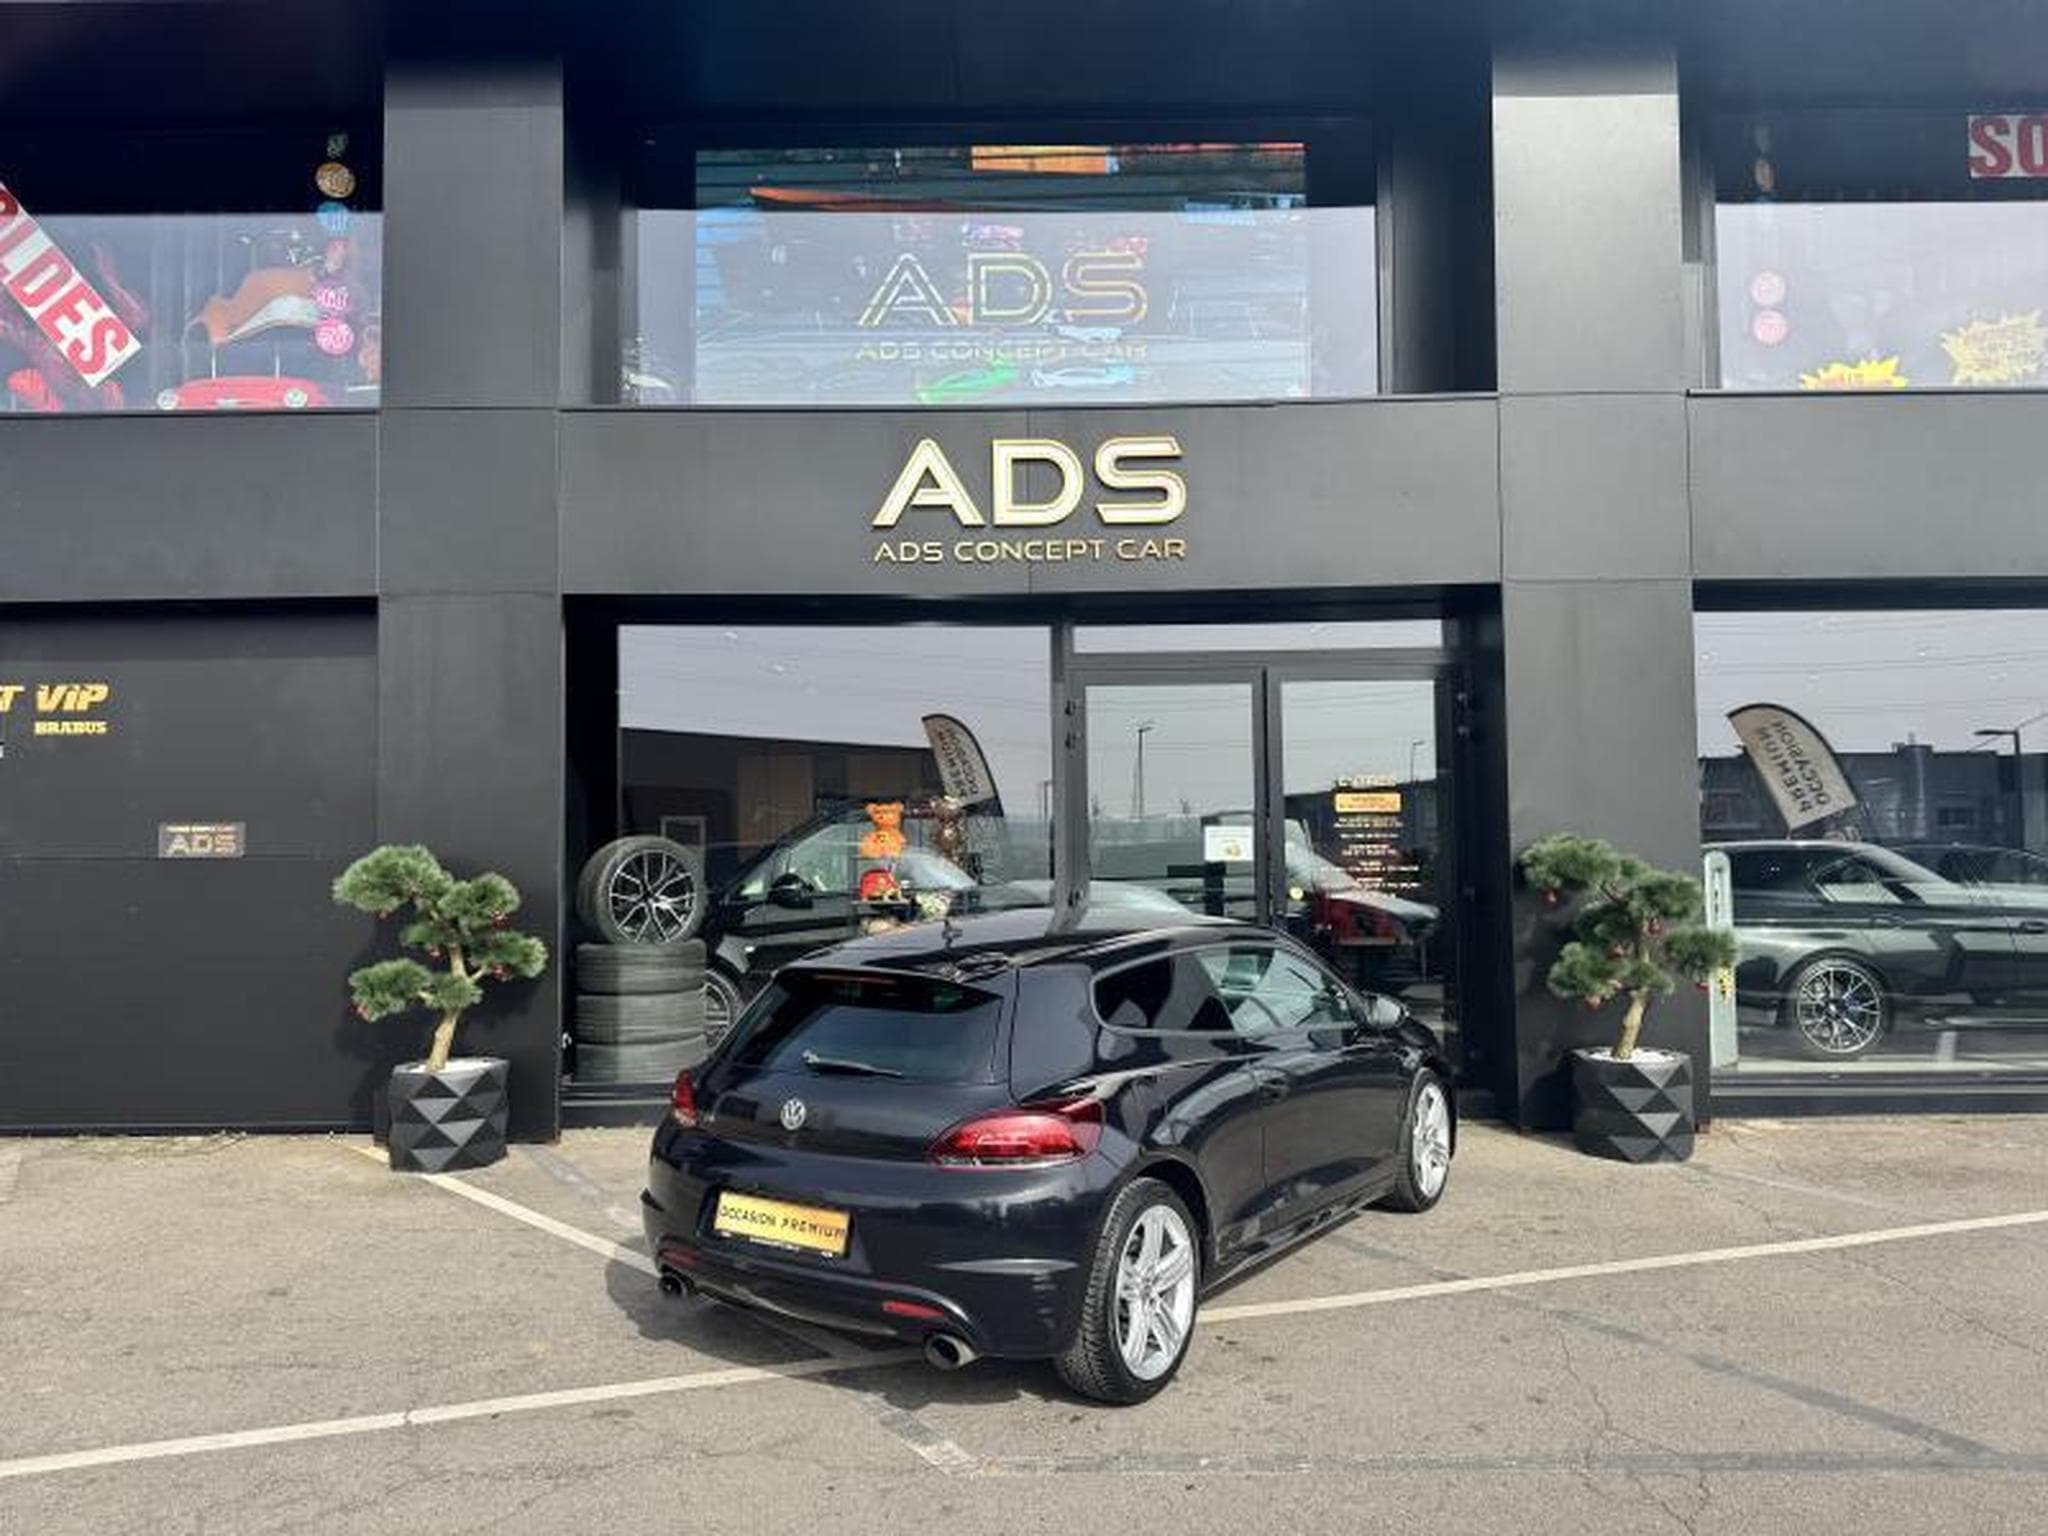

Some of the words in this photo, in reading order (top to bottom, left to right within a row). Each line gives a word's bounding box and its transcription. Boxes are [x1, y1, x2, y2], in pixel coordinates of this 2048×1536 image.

[858, 251, 1148, 326] ADS
[871, 436, 1187, 527] ADS
[873, 541, 943, 562] ADS
[953, 539, 1104, 562] CONCEPT
[1115, 538, 1187, 561] CAR
[34, 721, 108, 735] BRABUS
[167, 834, 237, 856] ADS
[719, 1203, 777, 1227] OCCASION
[780, 1216, 847, 1240] PREMIUM
